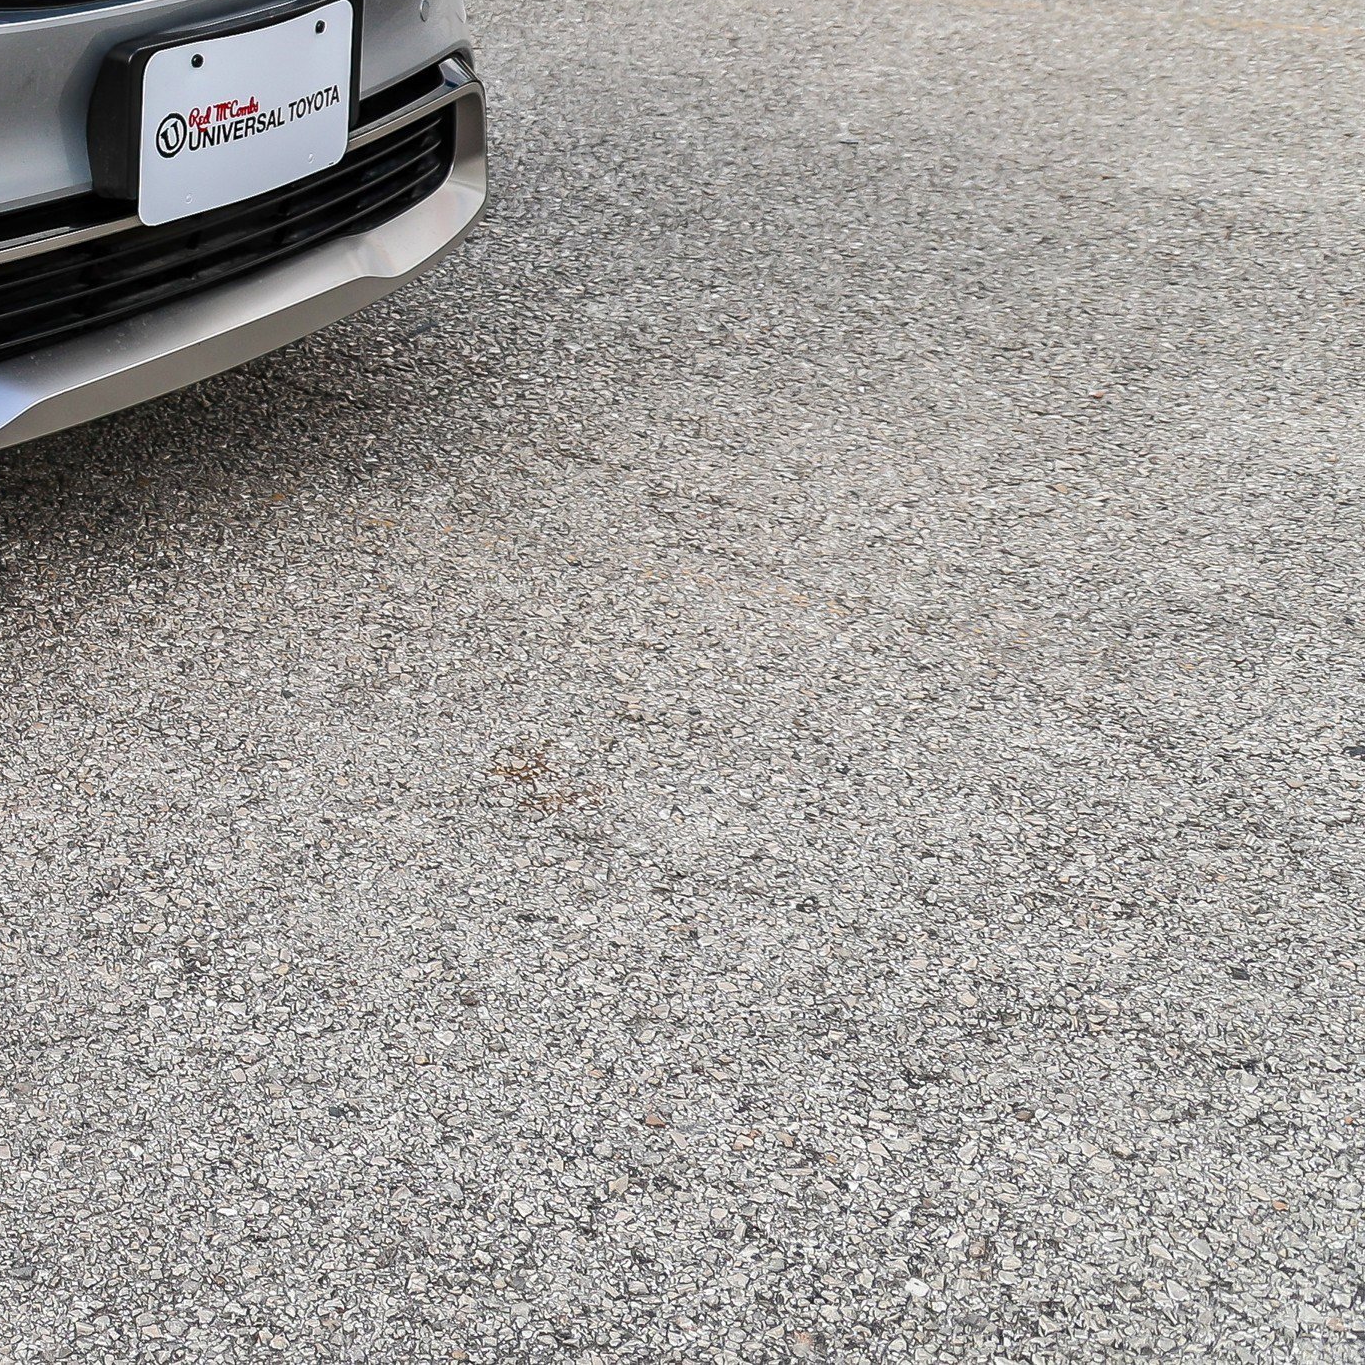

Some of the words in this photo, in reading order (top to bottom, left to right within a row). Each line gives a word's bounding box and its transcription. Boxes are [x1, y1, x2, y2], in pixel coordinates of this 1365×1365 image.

[188, 106, 212, 129] Red
[188, 107, 285, 151] UNIVERSAL
[288, 84, 340, 122] TOYOTA
